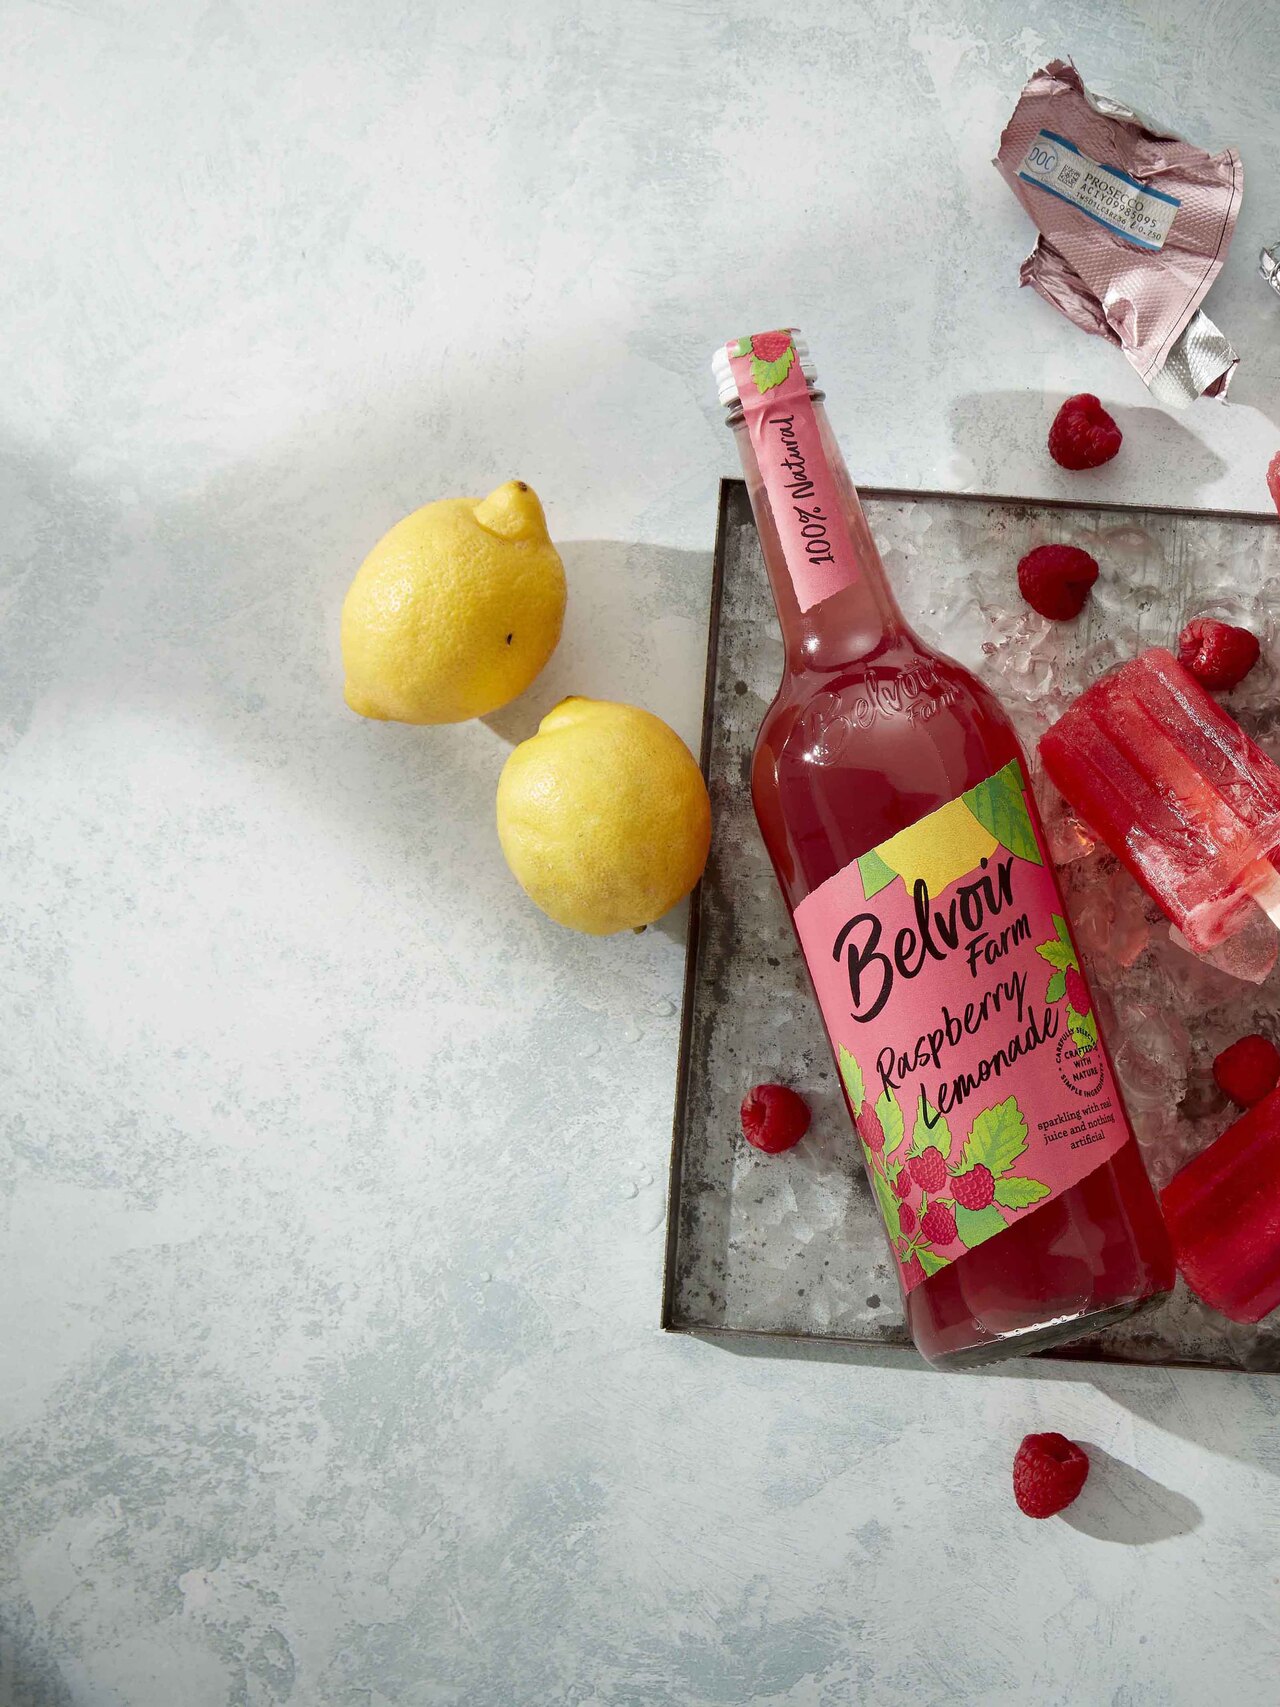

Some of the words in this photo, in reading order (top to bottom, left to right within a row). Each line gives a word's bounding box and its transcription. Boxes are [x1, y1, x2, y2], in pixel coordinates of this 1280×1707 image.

[1028, 147, 1055, 170] DOC
[1084, 173, 1144, 211] PROSECCO
[769, 414, 815, 500] Natural
[795, 506, 835, 567] 100%
[832, 856, 1015, 1023] Belvoir
[964, 913, 1032, 978] Farm
[875, 970, 1028, 1103] Raspberry
[1056, 1027, 1074, 1064] CAREFULLY
[1064, 1044, 1094, 1060] CRAFTED
[918, 1006, 1060, 1131] Lemonade
[1072, 1067, 1098, 1082] NATURE
[1073, 1057, 1092, 1069] WITH
[1060, 1074, 1082, 1097] SIMPLE
[1037, 1110, 1082, 1131] sparkling
[1081, 1102, 1100, 1117] with
[1100, 1097, 1112, 1110] real
[1043, 1130, 1069, 1146] juice
[1069, 1121, 1087, 1135] and
[1087, 1113, 1116, 1129] nothing
[1070, 1129, 1106, 1150] artificial
